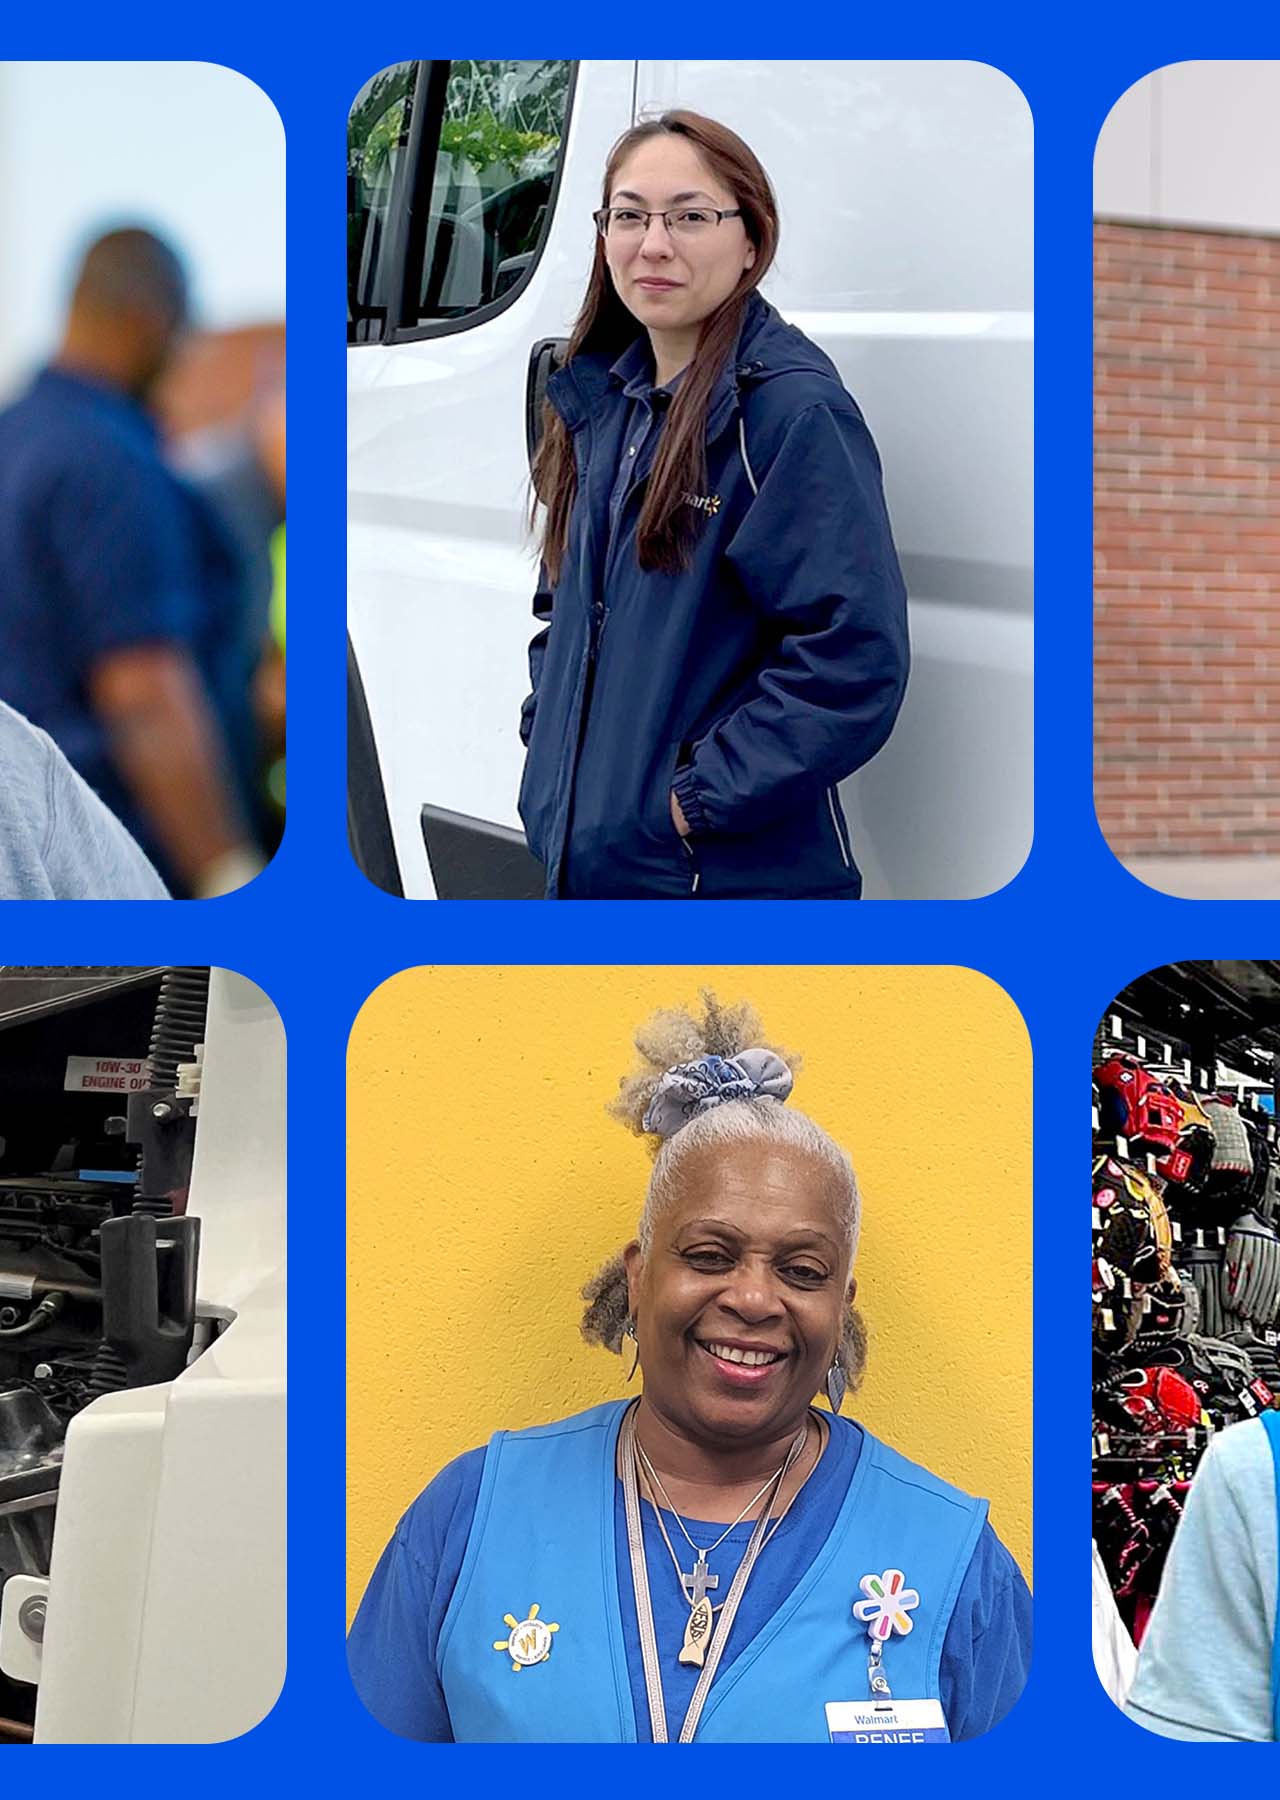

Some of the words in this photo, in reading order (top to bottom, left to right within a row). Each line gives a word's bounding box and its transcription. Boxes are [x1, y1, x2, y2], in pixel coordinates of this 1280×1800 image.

[95, 1061, 142, 1074] 10W-30
[81, 1075, 126, 1089] ENGINE
[854, 1714, 899, 1726] Walmart
